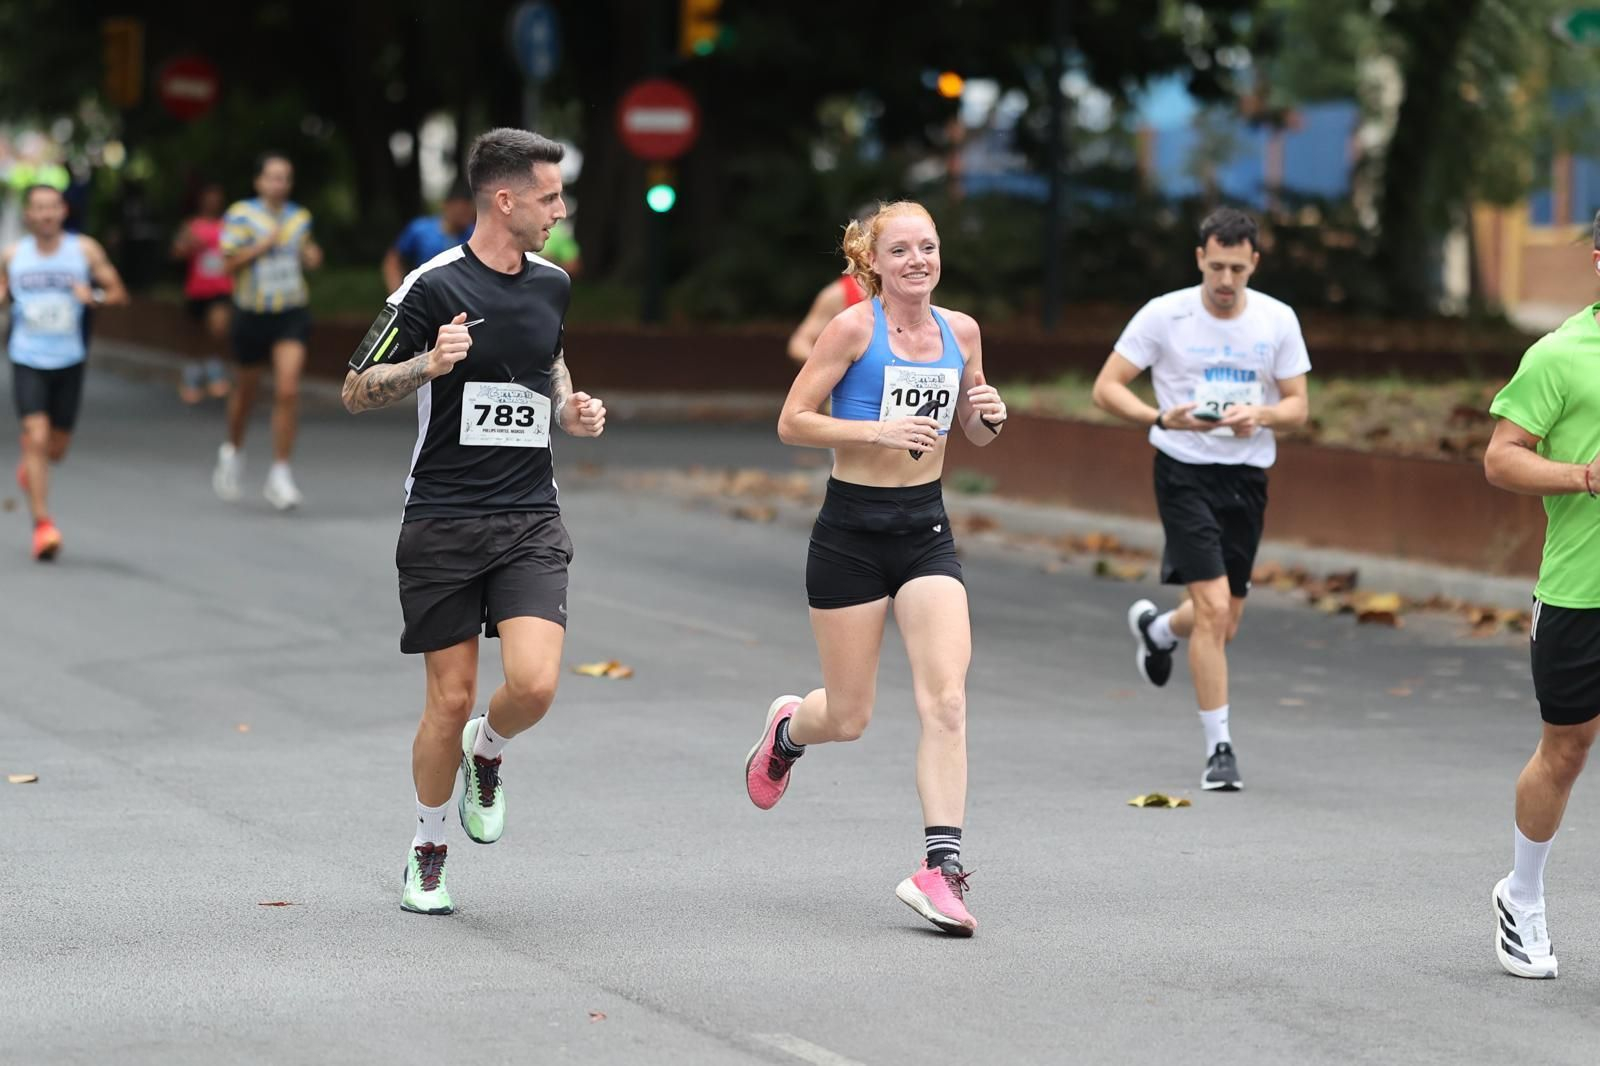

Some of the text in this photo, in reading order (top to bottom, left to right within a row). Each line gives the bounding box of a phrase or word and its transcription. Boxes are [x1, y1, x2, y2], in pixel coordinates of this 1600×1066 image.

[1204, 366, 1256, 382] VUELTA
[890, 388, 950, 407] 1010
[474, 404, 535, 427] 783
